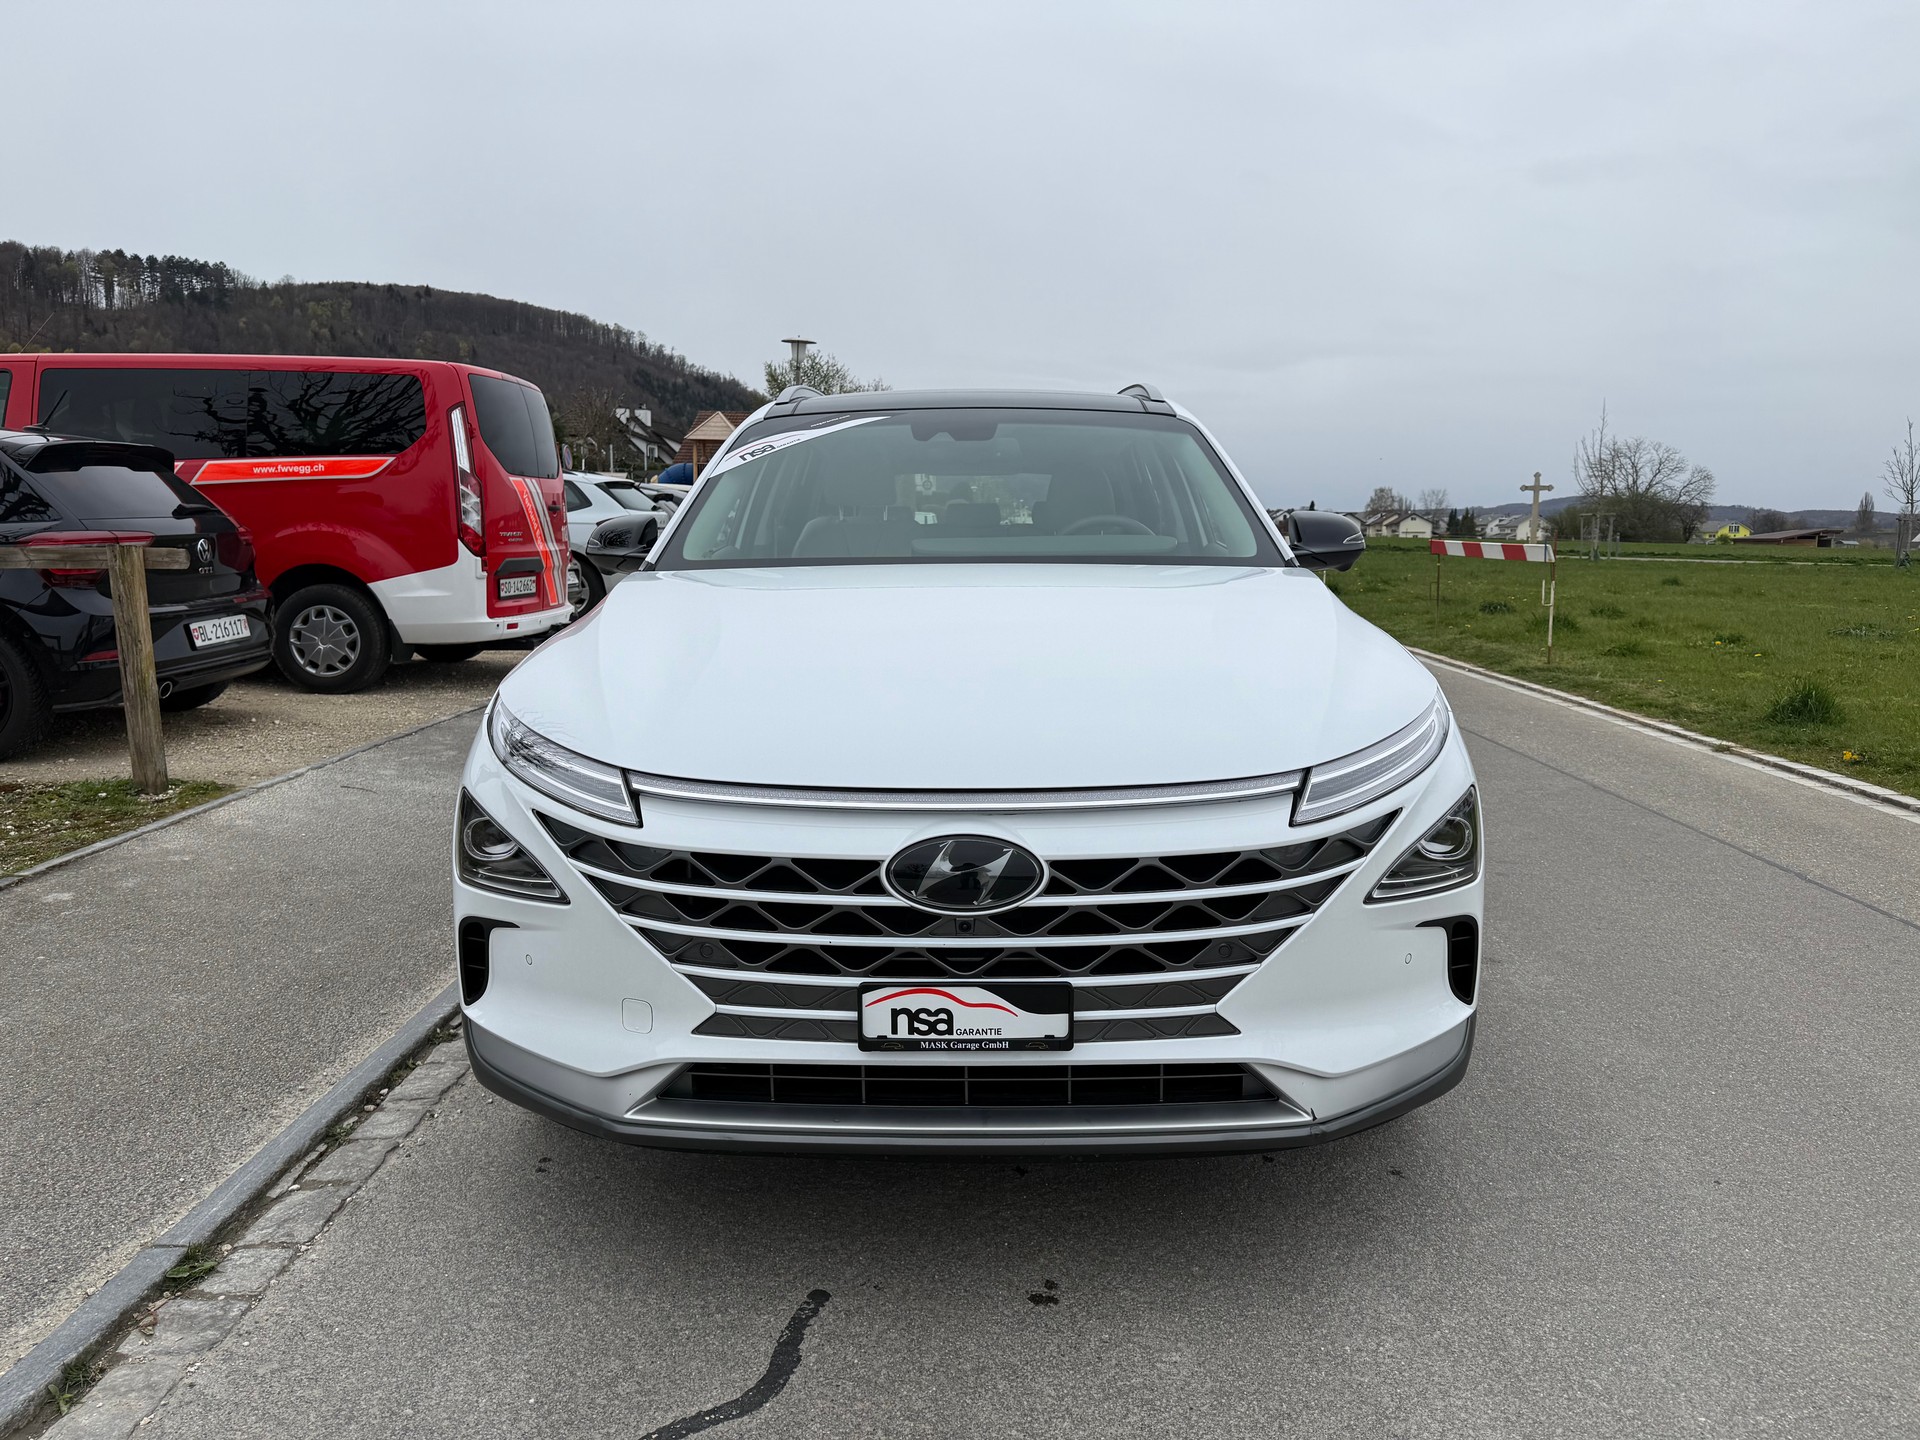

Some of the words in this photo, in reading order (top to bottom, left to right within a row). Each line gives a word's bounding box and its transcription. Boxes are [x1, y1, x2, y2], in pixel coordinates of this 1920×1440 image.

[739, 444, 776, 462] nsa
[252, 463, 325, 475] www.fwvegg.ch
[198, 566, 214, 574] GTI
[890, 1007, 954, 1036] nsa
[955, 1027, 1003, 1036] GARANTIE
[920, 1041, 948, 1049] MASK
[950, 1041, 980, 1051] Garage
[983, 1041, 1010, 1049] GmbH
